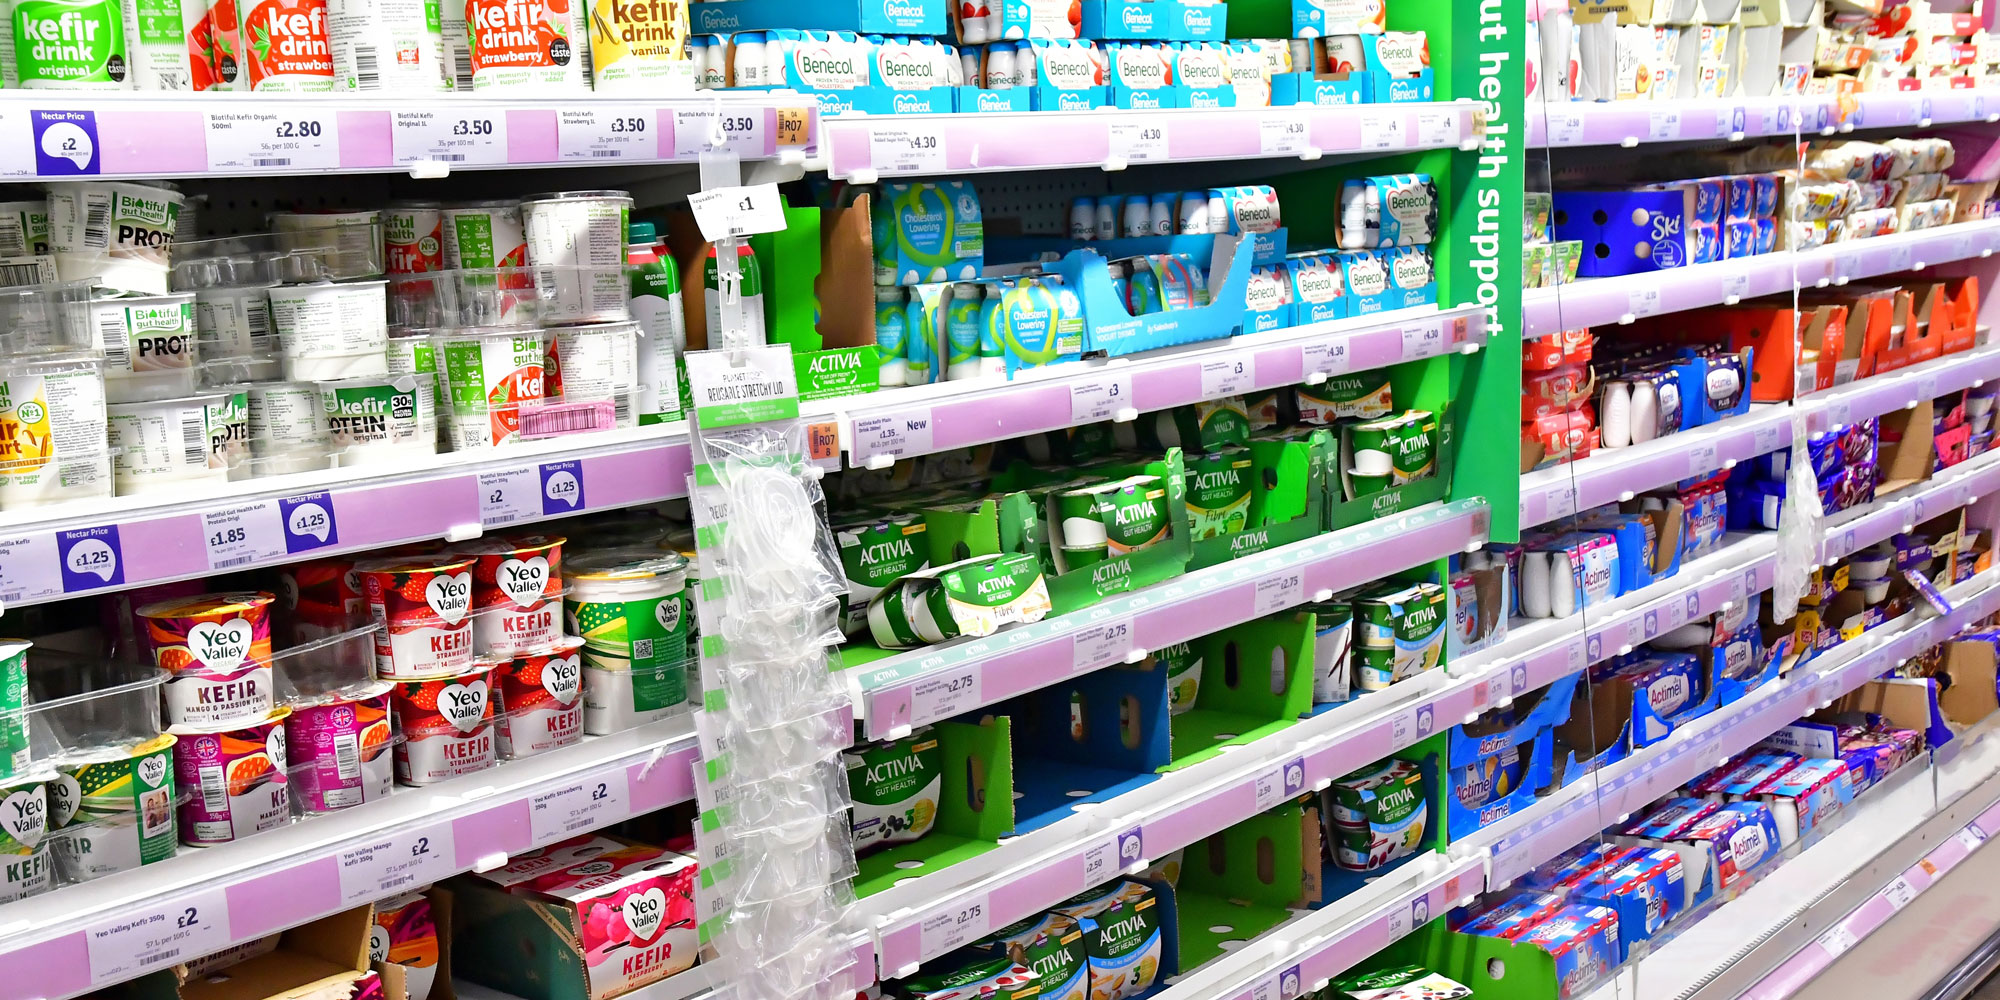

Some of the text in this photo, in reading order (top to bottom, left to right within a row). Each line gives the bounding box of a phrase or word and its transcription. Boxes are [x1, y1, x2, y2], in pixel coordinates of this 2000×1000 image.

[472, 0, 542, 30] kefir
[888, 4, 925, 17] Benecol
[22, 11, 100, 42] kefir
[621, 23, 675, 42] drink
[482, 26, 538, 49] drink
[32, 40, 95, 62] drink
[481, 51, 543, 65] strawberry
[631, 45, 670, 56] vanilla
[1381, 46, 1414, 60] Benecol
[38, 65, 91, 78] original
[803, 56, 854, 74] Benecol
[1184, 64, 1220, 78] Benecol
[1392, 88, 1418, 101] Benecol
[897, 100, 931, 113] Benecol
[41, 112, 65, 120] Nectar
[253, 114, 277, 122] Organic
[1443, 117, 1451, 128] £4
[1478, 52, 1509, 178] health
[276, 121, 321, 138] £2.80
[453, 120, 492, 135] £3.50
[611, 118, 645, 132] £3.50
[722, 118, 753, 131] £3.50
[785, 120, 802, 132] R07
[1286, 123, 1304, 134] £4.30
[790, 134, 796, 143] A
[1140, 129, 1161, 140] £4.30
[62, 138, 76, 151] £2
[911, 136, 936, 149] £4.30
[739, 196, 755, 211] £1
[1391, 195, 1428, 210] Benecol
[120, 208, 164, 221] gut health
[905, 212, 943, 223] Cholesterol
[1239, 209, 1271, 222] Benecol
[909, 224, 941, 234] Lowering
[1651, 214, 1680, 241] Ski
[1469, 189, 1504, 337] support
[1398, 264, 1426, 278] Benecol
[1302, 278, 1331, 292] Benecol
[1353, 272, 1382, 286] Benecol
[1248, 287, 1277, 301] Benecol
[135, 309, 179, 320] Biotiful
[1013, 309, 1049, 321] Cholesterol
[136, 316, 179, 330] gut health
[1017, 320, 1046, 332] Lowering
[808, 352, 862, 375] ACTIVIA
[1234, 361, 1243, 375] £3
[707, 381, 783, 402] REUSABLE STRETCHY LID
[1109, 383, 1119, 397] £3
[1325, 380, 1362, 392] ACTIVIA
[1710, 377, 1732, 391] Actimel
[340, 394, 387, 415] kefir
[391, 396, 412, 408] 30g
[1718, 399, 1730, 408] PLUS
[906, 420, 927, 432] New
[353, 432, 387, 443] original
[819, 434, 835, 446] R07
[880, 429, 896, 439] £1.35
[1399, 433, 1430, 456] ACTIVIA
[545, 462, 575, 472] Nectar Price
[552, 481, 575, 494] £1.25
[1194, 469, 1240, 491] ACTIVIA
[287, 493, 323, 505] Nectar Price
[490, 489, 503, 504] £2
[1201, 490, 1233, 501] GUT HEALTH
[1115, 501, 1157, 526] ACTIVIA
[1205, 509, 1228, 524] Fibre
[1694, 509, 1719, 529] Actimel
[297, 514, 325, 530] £1.25
[66, 528, 108, 540] Nectar Price
[210, 528, 246, 547] £1.85
[1230, 531, 1269, 552] ACTIVIA
[76, 550, 109, 567] £1.25
[860, 539, 914, 567] ACTIVIA
[506, 566, 541, 582] Yeo
[869, 563, 907, 578] GUT HEALTH
[1091, 558, 1132, 584] ACTIVIA
[1584, 565, 1611, 587] Actimel
[507, 579, 542, 595] Valley
[977, 575, 1016, 596] ACTIVIA
[1281, 575, 1298, 591] £2.75
[987, 591, 1012, 603] GUT HEALTH
[661, 603, 678, 614] Yeo
[503, 611, 552, 633] KEFIR
[661, 612, 678, 624] Valley
[1403, 606, 1437, 631] ACTIVIA
[199, 627, 242, 649] Yeo
[509, 629, 549, 641] STRAWBERRY
[1105, 624, 1127, 640] £2.75
[201, 643, 244, 662] Valley
[551, 662, 577, 679] Yeo
[552, 676, 578, 694] Valley
[948, 675, 973, 693] £2.75
[197, 680, 257, 705] KEFIR
[448, 690, 481, 707] Yeo
[1651, 684, 1682, 707] Actimel
[449, 703, 483, 720] Valley
[444, 736, 490, 760] KEFIR
[144, 759, 163, 772] Yeo
[865, 754, 924, 786] ACTIVIA
[556, 785, 582, 798] Strawberry
[592, 783, 608, 801] £2
[875, 778, 917, 797] GUT HEALTH
[1456, 774, 1493, 801] Actimel
[535, 803, 547, 812] 350g
[1377, 787, 1414, 814] ACTIVIA
[12, 798, 43, 819] Yeo
[260, 811, 279, 820] MANGO
[1479, 799, 1511, 826] Actimel
[343, 842, 392, 860] Yeo Valley Mango
[411, 837, 429, 857] £2
[1734, 832, 1761, 859] Actimel
[1086, 858, 1102, 873] £2.50
[19, 891, 27, 899] 14
[630, 898, 657, 916] Yeo
[957, 904, 981, 925] £2.75
[177, 907, 199, 928] £2
[631, 910, 660, 929] Valley
[95, 913, 165, 939] Yeo Valley Kefir 350g
[1100, 914, 1147, 947] ACTIVIA
[1108, 936, 1142, 956] GUT HEALTH
[622, 943, 672, 976] KEFIR
[628, 961, 664, 982] RASPBERRY
[1131, 966, 1140, 986] 3
[1568, 957, 1599, 985] Actimel
